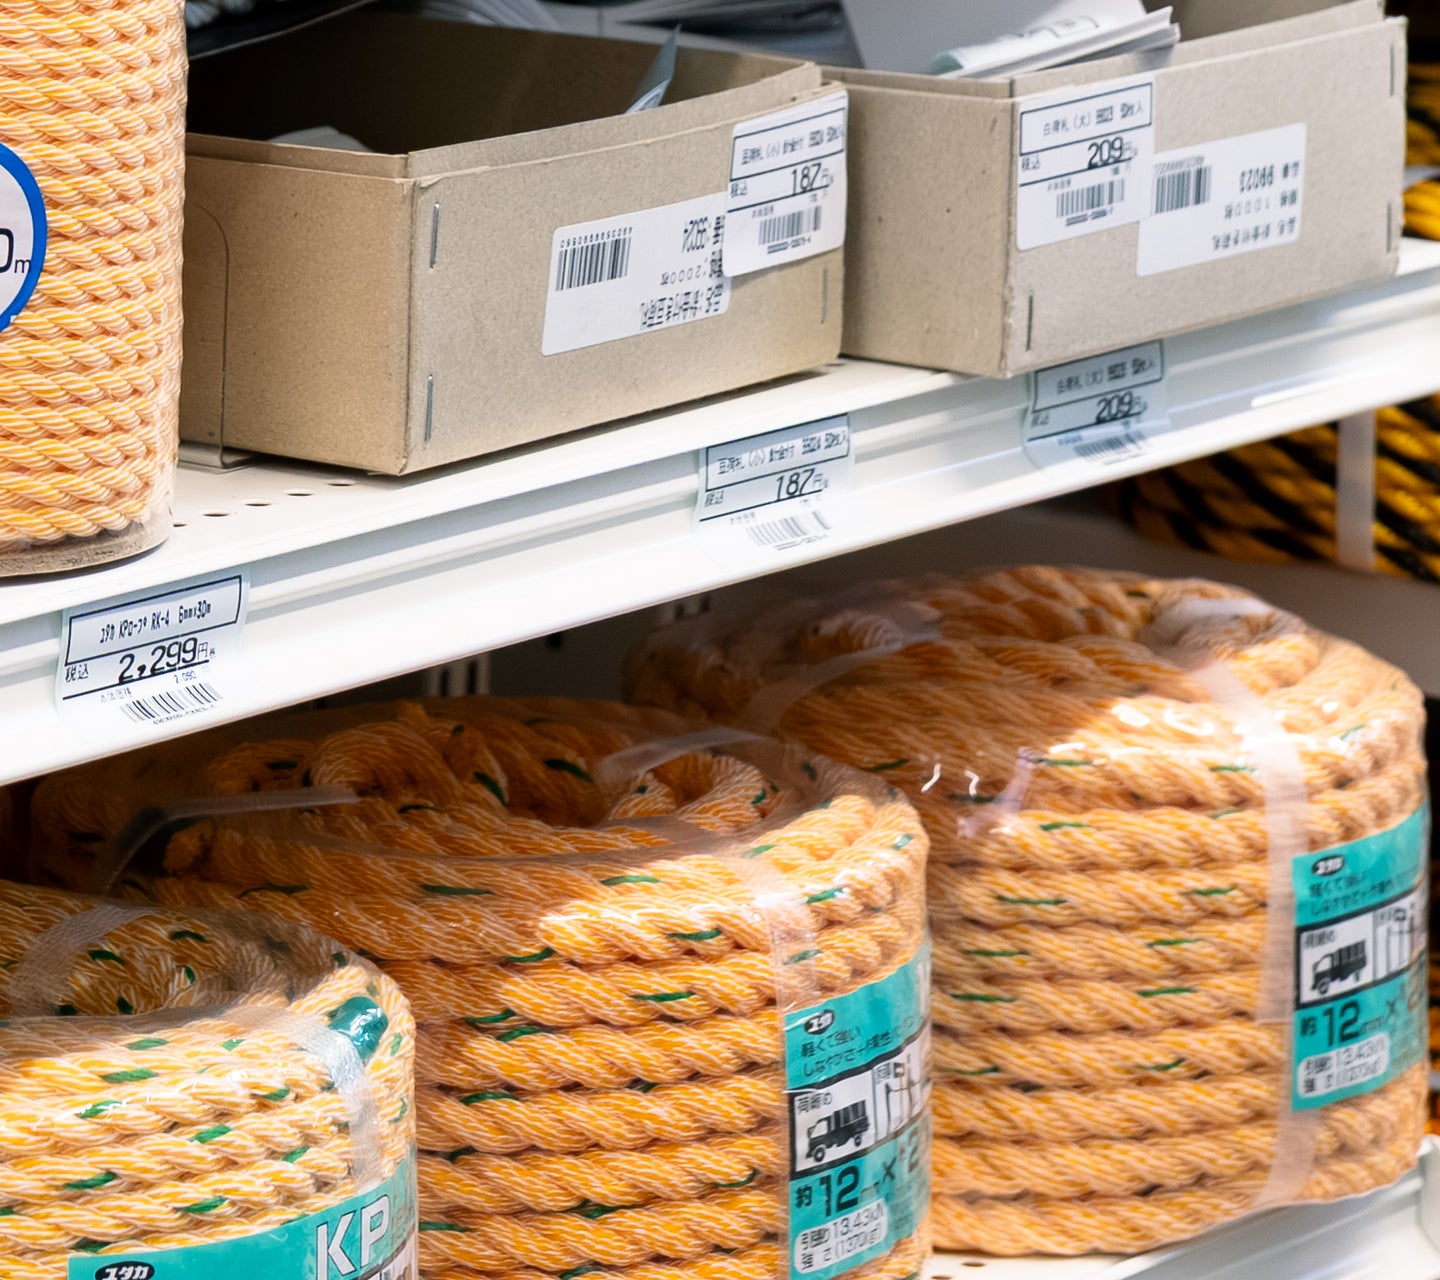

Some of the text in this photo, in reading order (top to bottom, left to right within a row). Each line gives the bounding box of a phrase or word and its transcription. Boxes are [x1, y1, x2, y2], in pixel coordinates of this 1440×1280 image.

[65, 636, 209, 686] 税込 2,299円
[316, 1194, 391, 1280] KP
